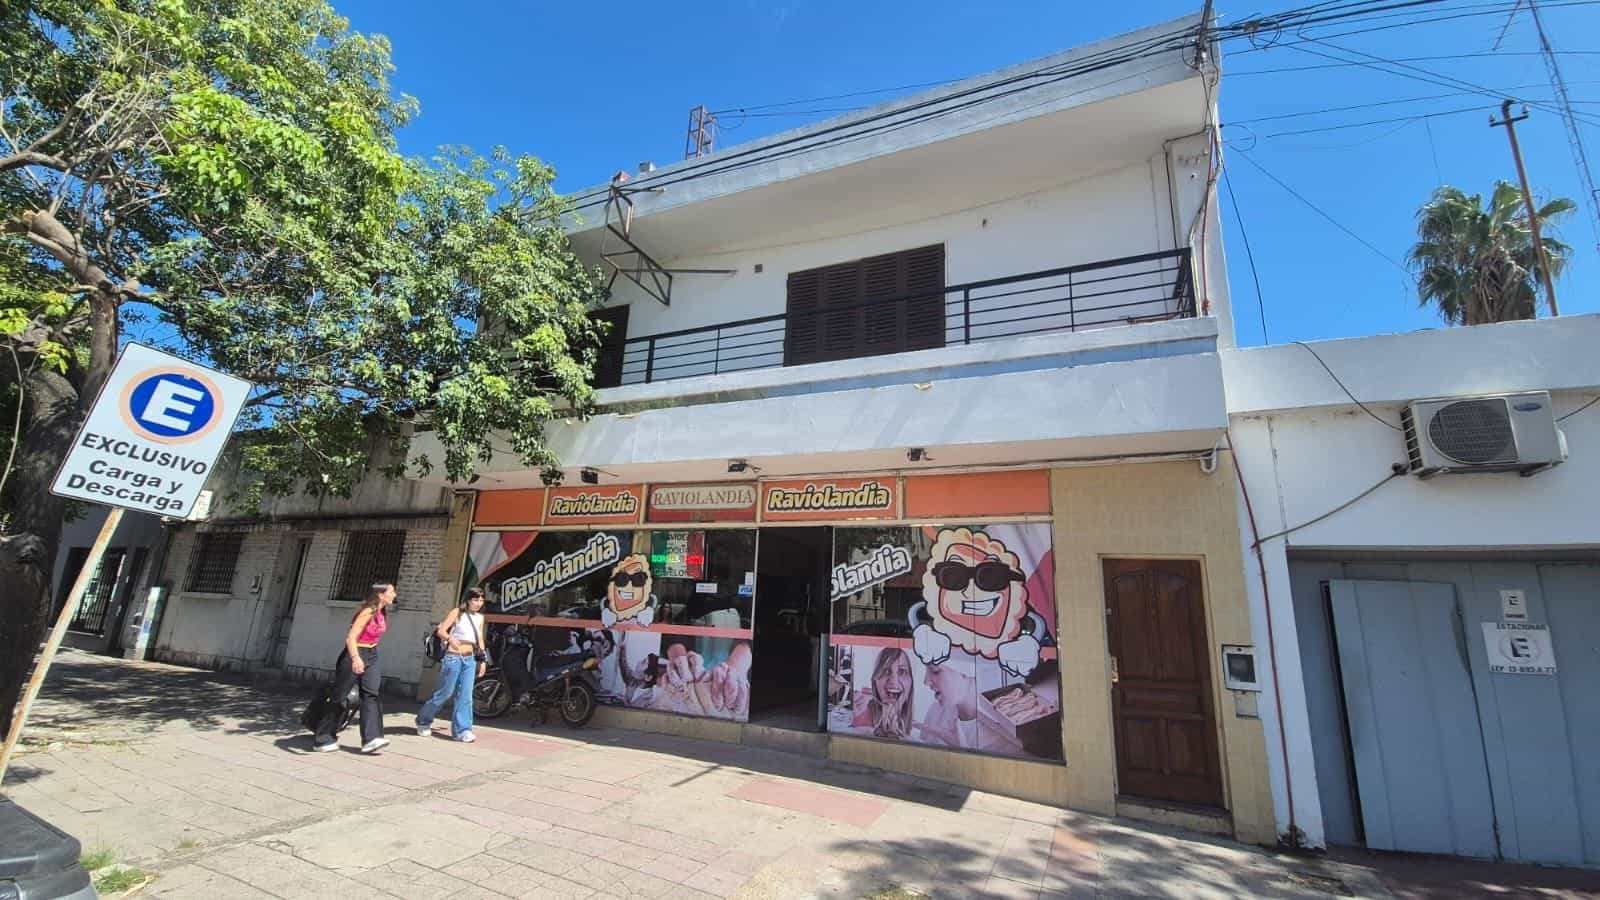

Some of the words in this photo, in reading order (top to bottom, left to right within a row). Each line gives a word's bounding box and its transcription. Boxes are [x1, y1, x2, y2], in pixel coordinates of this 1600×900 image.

[141, 379, 204, 432] E
[81, 433, 207, 475] EXCLUSIVO
[66, 474, 184, 510] Descarga
[89, 460, 162, 487] Carga
[166, 481, 183, 494] y
[551, 493, 635, 515] Raviolandia
[654, 489, 753, 505] RAVIOLANDIA
[768, 483, 888, 510] Raviolandia
[503, 537, 617, 606] Raviolandia
[1511, 638, 1531, 658] E
